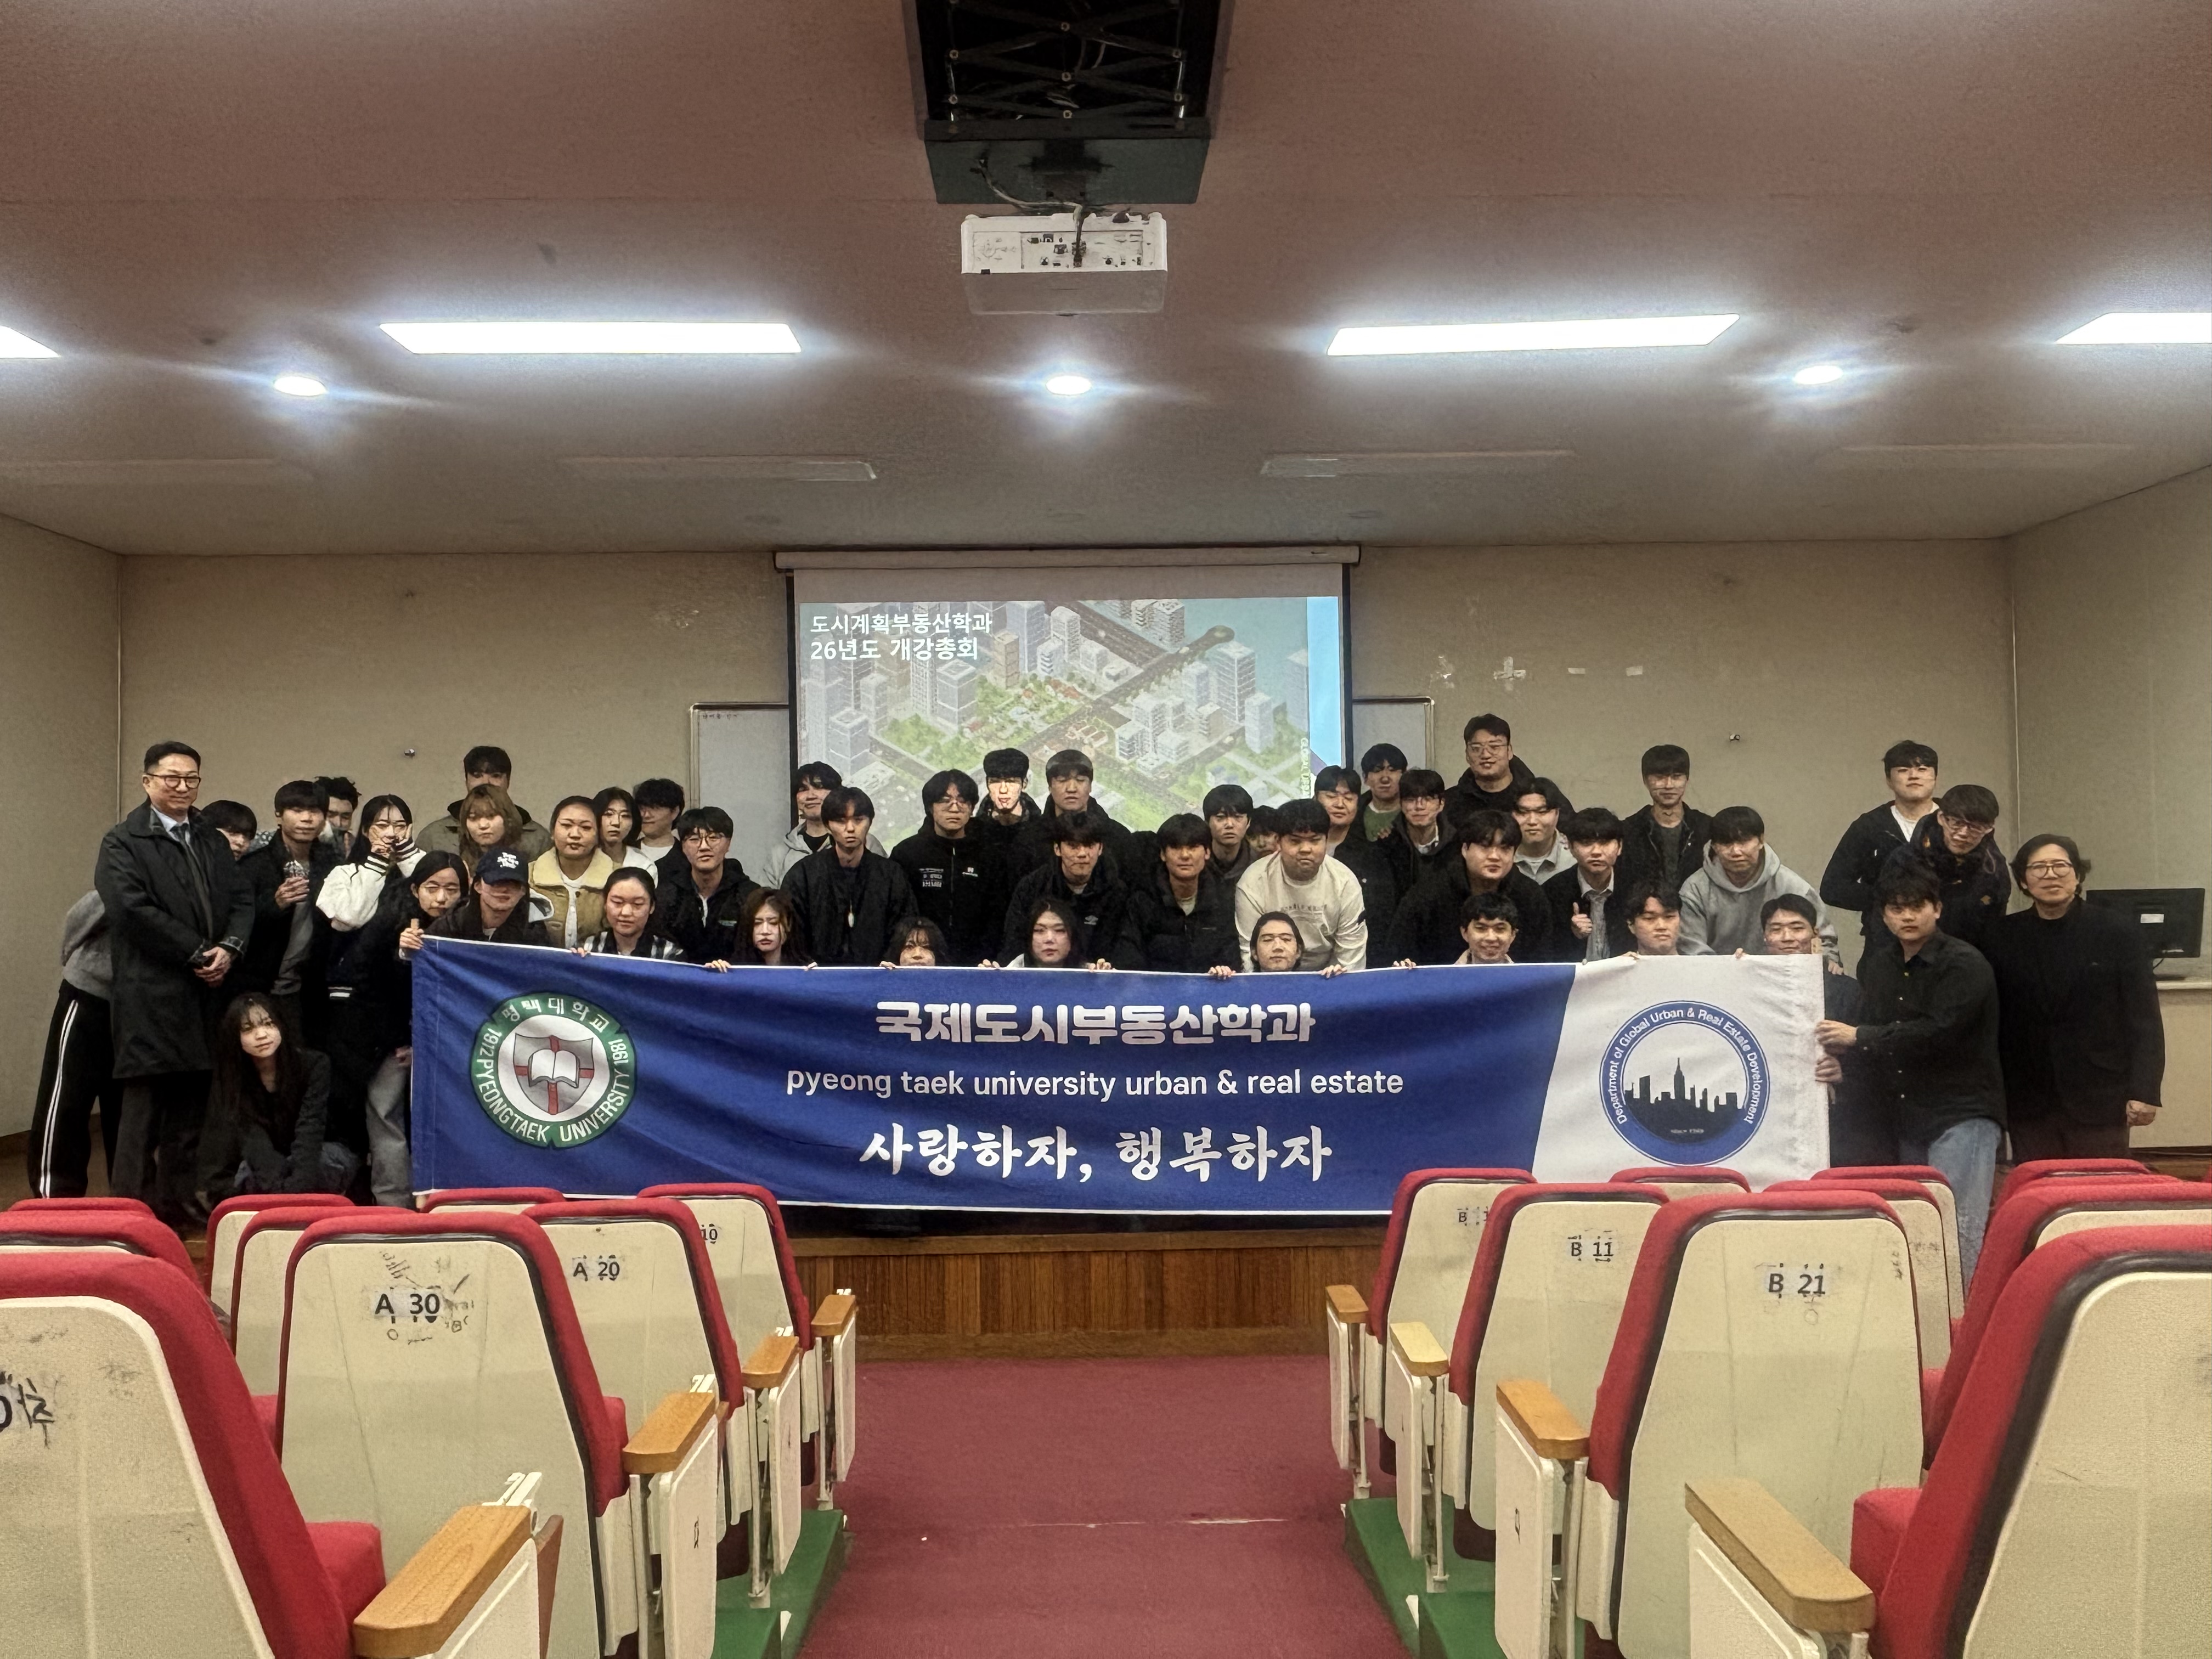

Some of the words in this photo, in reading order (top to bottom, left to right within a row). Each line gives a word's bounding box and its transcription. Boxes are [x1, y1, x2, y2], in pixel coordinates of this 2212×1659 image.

[810, 612, 992, 634] 도시계획부동산학과
[810, 639, 882, 661] 26년도
[890, 636, 978, 661] 개강총회
[876, 1001, 1317, 1045] 국제도시부동산학과
[479, 1028, 503, 1057] 1972
[608, 1039, 629, 1065] 1981
[1608, 1060, 1628, 1125] Department
[1619, 1018, 1651, 1047] Global
[1650, 1009, 1685, 1023] Urban
[1686, 1007, 1695, 1018] &
[1697, 1009, 1724, 1026] Real
[1723, 1020, 1751, 1052] Estate
[1743, 1052, 1763, 1125] Development
[786, 1070, 891, 1099] pyeong
[900, 1070, 965, 1094] taek
[974, 1070, 1116, 1102] university
[1126, 1070, 1207, 1095] urban
[1217, 1069, 1239, 1095] &
[1248, 1069, 1301, 1094] real
[1310, 1070, 1404, 1094] estate
[476, 1059, 550, 1143] PYEONGTAEK
[559, 1068, 630, 1142] UNIVERSITY
[859, 1122, 1093, 1183] 사랑하자,
[1115, 1125, 1333, 1182] 행복하자
[1458, 1212, 1468, 1223] B
[1571, 1242, 1583, 1256] B
[1592, 1242, 1614, 1257] 11
[573, 1262, 588, 1277] A
[597, 1261, 620, 1277] 20
[1768, 1273, 1784, 1293] B
[1797, 1274, 1826, 1295] 21
[374, 1293, 395, 1314] A
[409, 1293, 441, 1314] 30
